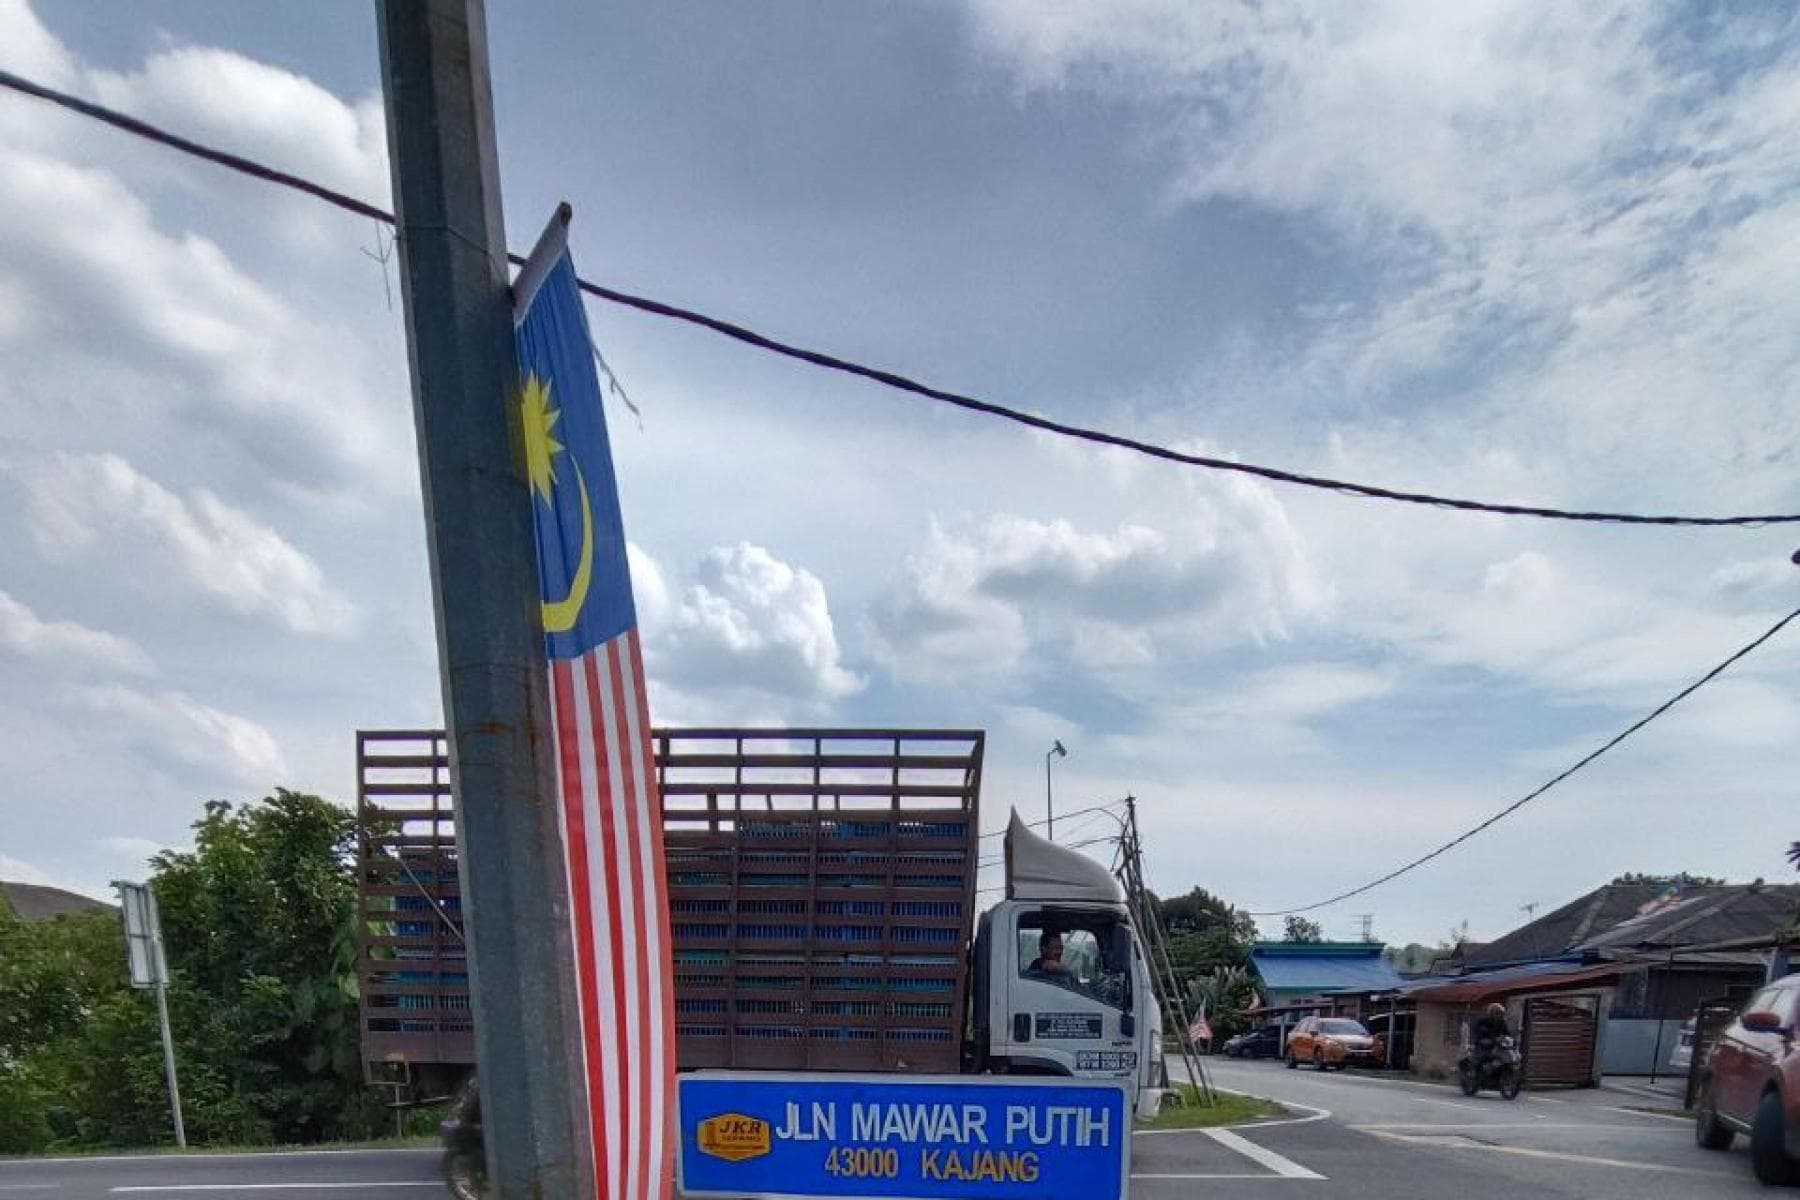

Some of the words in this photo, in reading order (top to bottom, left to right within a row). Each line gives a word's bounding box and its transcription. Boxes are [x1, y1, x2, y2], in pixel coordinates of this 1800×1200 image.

[719, 1120, 763, 1134] JKR
[776, 1101, 836, 1141] JLN
[852, 1103, 987, 1144] MAWAR
[1006, 1105, 1110, 1147] PUTIH
[825, 1147, 898, 1178] 43000
[922, 1148, 1040, 1182] KAJANG
